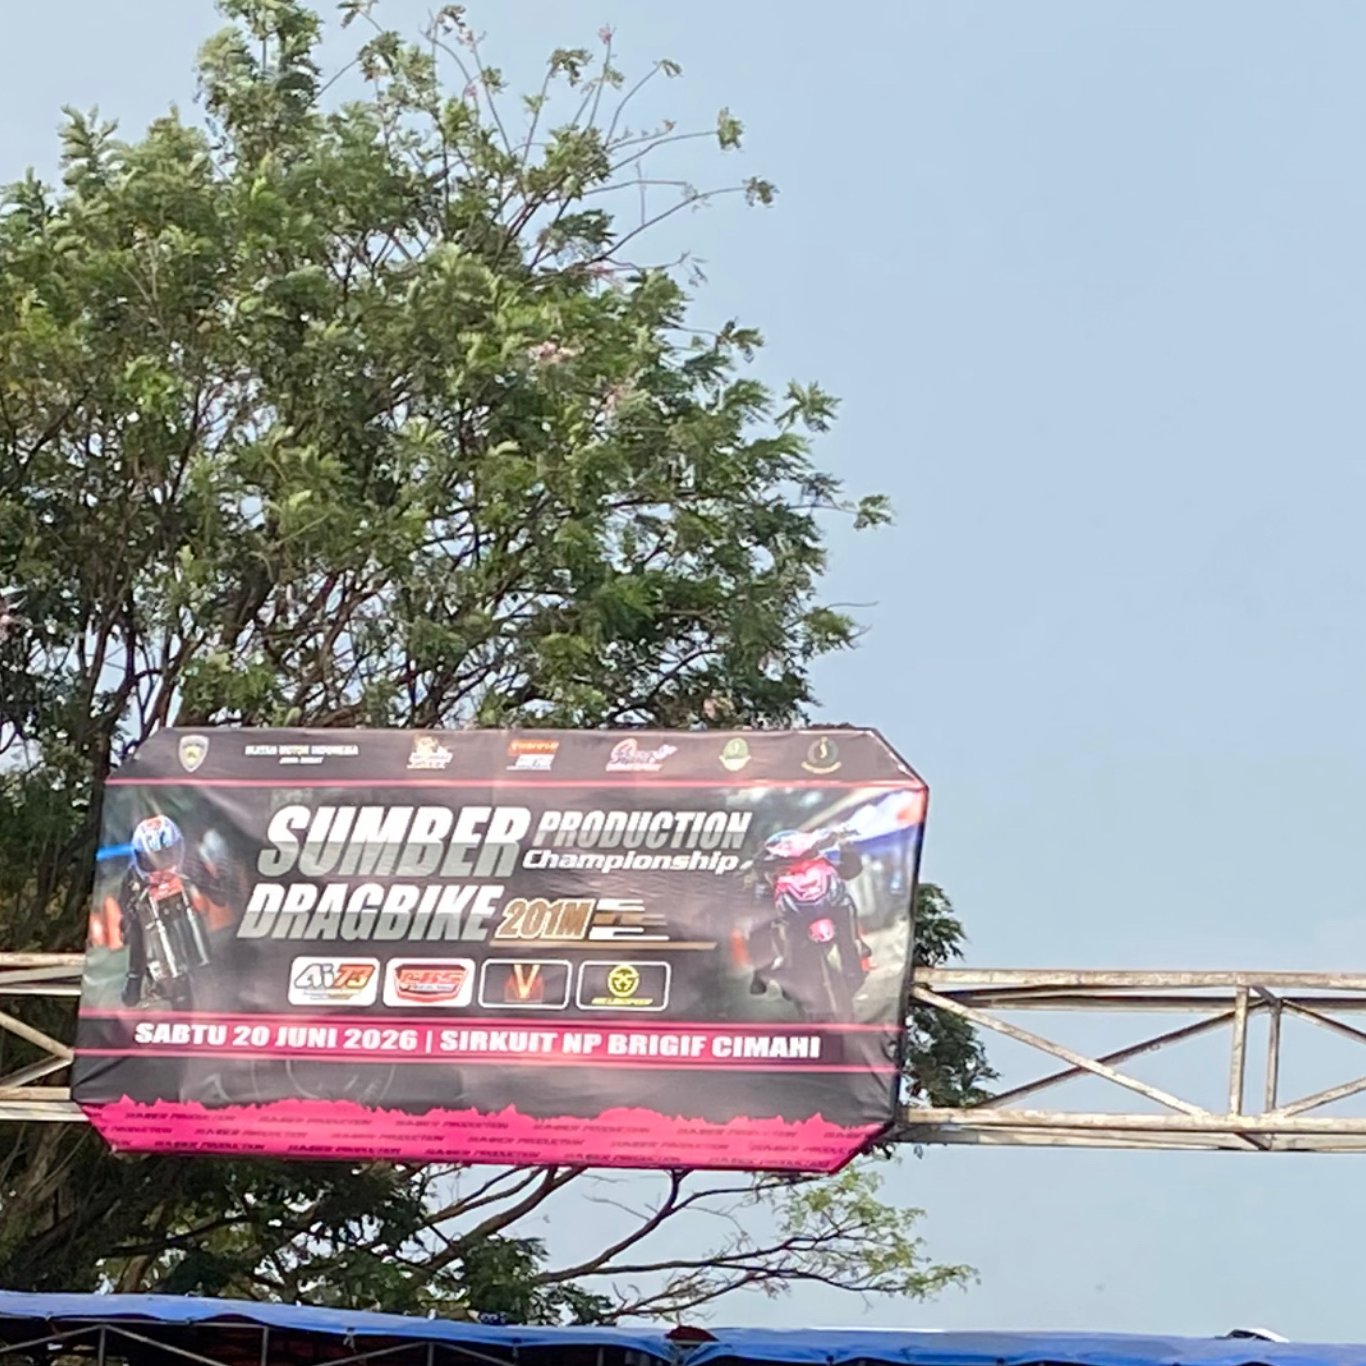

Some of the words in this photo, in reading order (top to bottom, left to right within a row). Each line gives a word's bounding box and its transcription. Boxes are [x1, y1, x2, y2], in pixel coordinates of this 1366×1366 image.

[257, 805, 532, 877] SUMBER
[533, 810, 753, 849] PRODUCTION
[522, 850, 740, 875] Championship
[236, 882, 505, 941] DRAGBIKE
[494, 898, 596, 939] 201M
[134, 1022, 227, 1046] SABTU
[232, 1025, 271, 1047] 20
[274, 1026, 338, 1049] JUNI
[343, 1029, 418, 1050] 2026
[439, 1030, 558, 1053] SIRKUIT
[561, 1032, 603, 1054] NP
[607, 1033, 708, 1057] BRIGIF
[711, 1036, 821, 1059] CIMAHI
